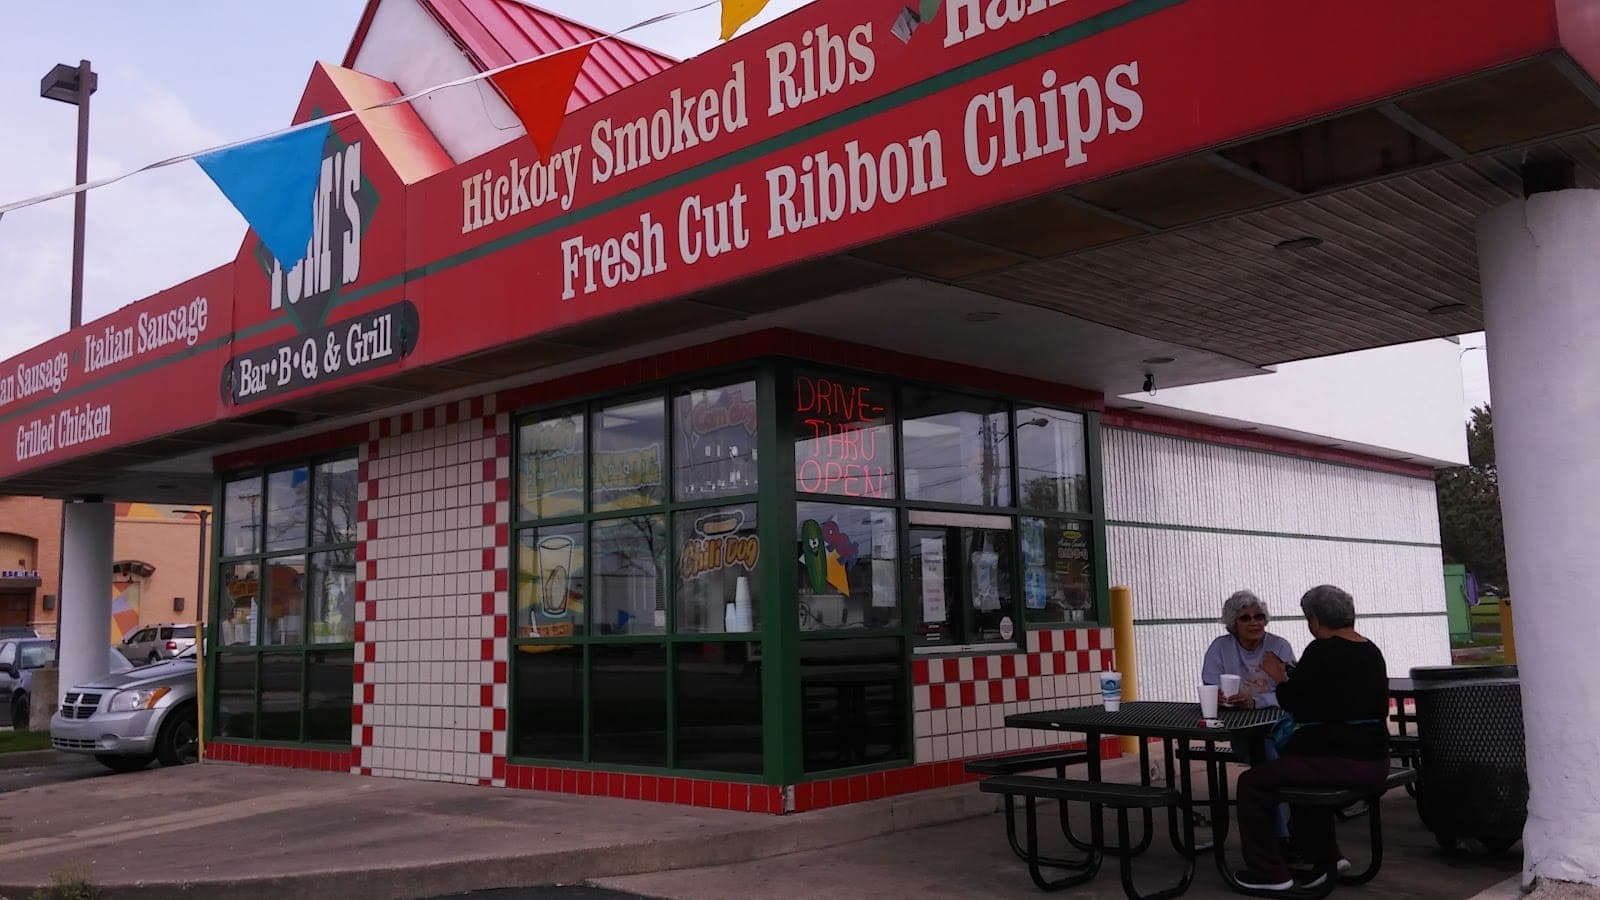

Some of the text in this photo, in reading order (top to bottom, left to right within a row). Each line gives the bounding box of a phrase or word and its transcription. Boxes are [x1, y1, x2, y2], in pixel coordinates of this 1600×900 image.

[461, 144, 582, 234] Hickory
[590, 61, 749, 184] Smoked
[766, 22, 876, 117] Ribs
[560, 61, 1144, 301] Fresh Cut Ribbon Chips
[17, 349, 68, 398] Sausage
[84, 312, 134, 373] Italian
[137, 296, 209, 354] Sausage
[322, 331, 342, 372] &
[346, 313, 393, 365] Grill
[796, 377, 884, 422] DRIVE-
[16, 403, 111, 461] Grilled Chicken
[804, 418, 876, 461] THRU
[799, 459, 883, 497] OPEN
[724, 537, 760, 571] Dog
